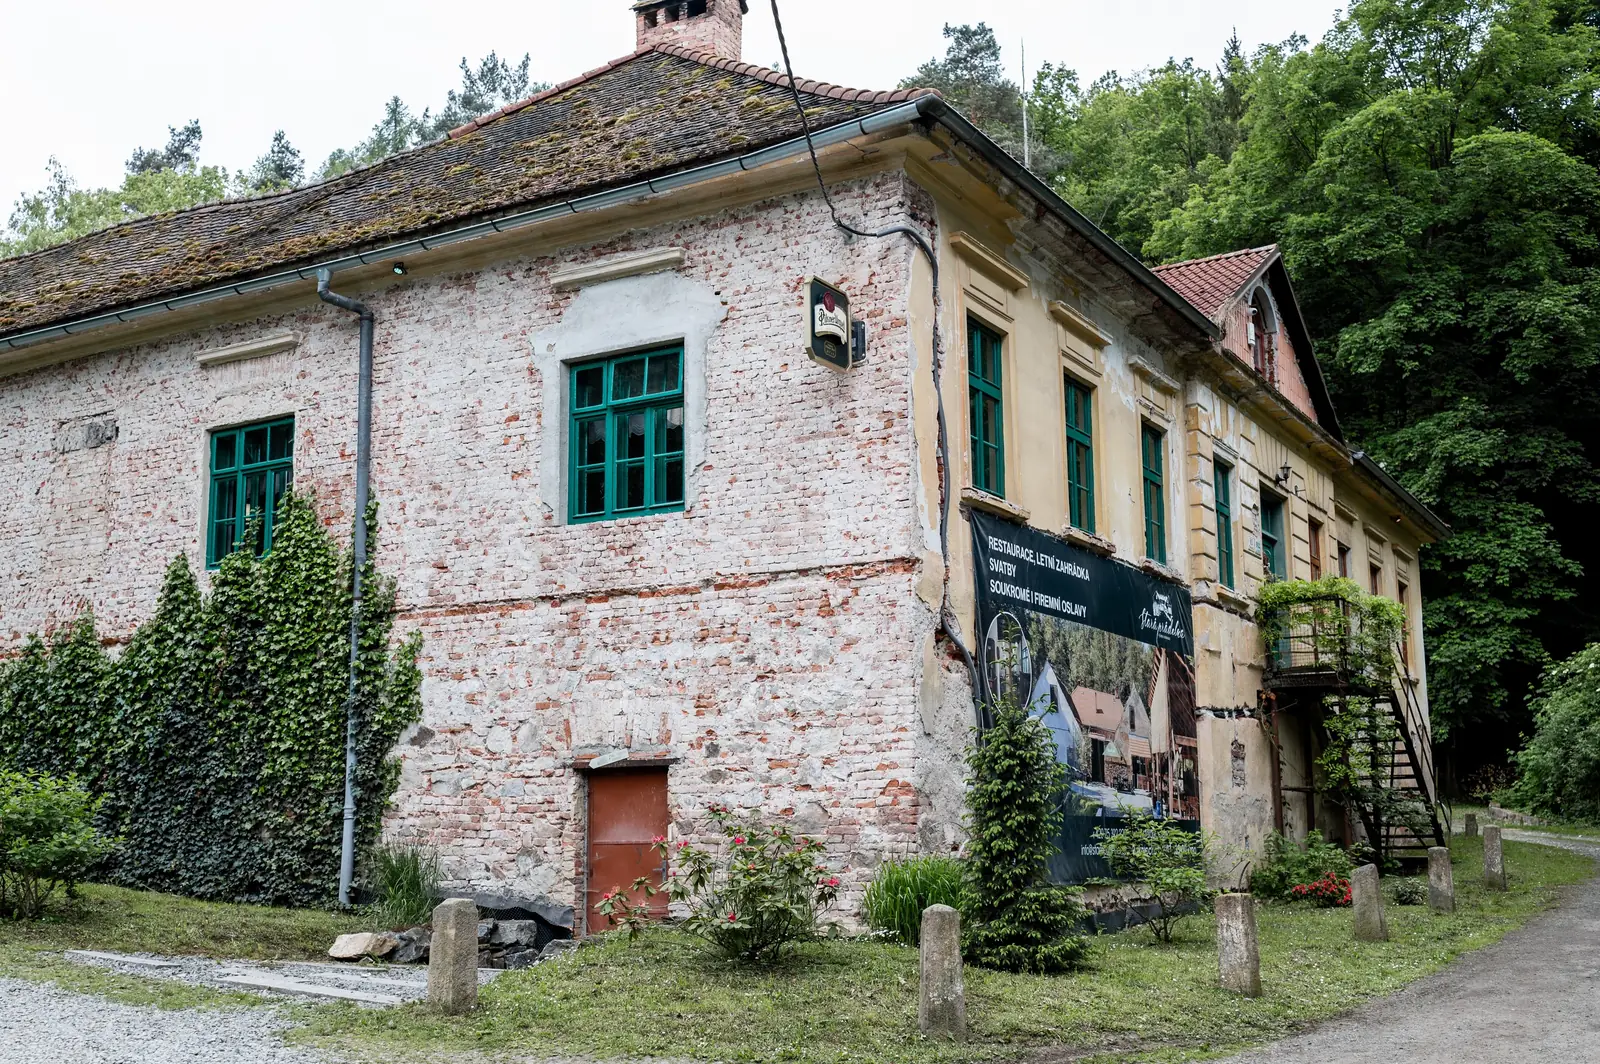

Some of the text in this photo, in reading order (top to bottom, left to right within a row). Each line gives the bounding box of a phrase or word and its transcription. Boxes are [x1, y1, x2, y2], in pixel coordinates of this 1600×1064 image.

[988, 535, 1090, 581] RESTAURACE, LETNÍ ZAHRÁDKA
[989, 557, 1017, 578] SVATBY
[990, 579, 1087, 618] SOUKROMÉ I FIREMNÍ OSLAVY
